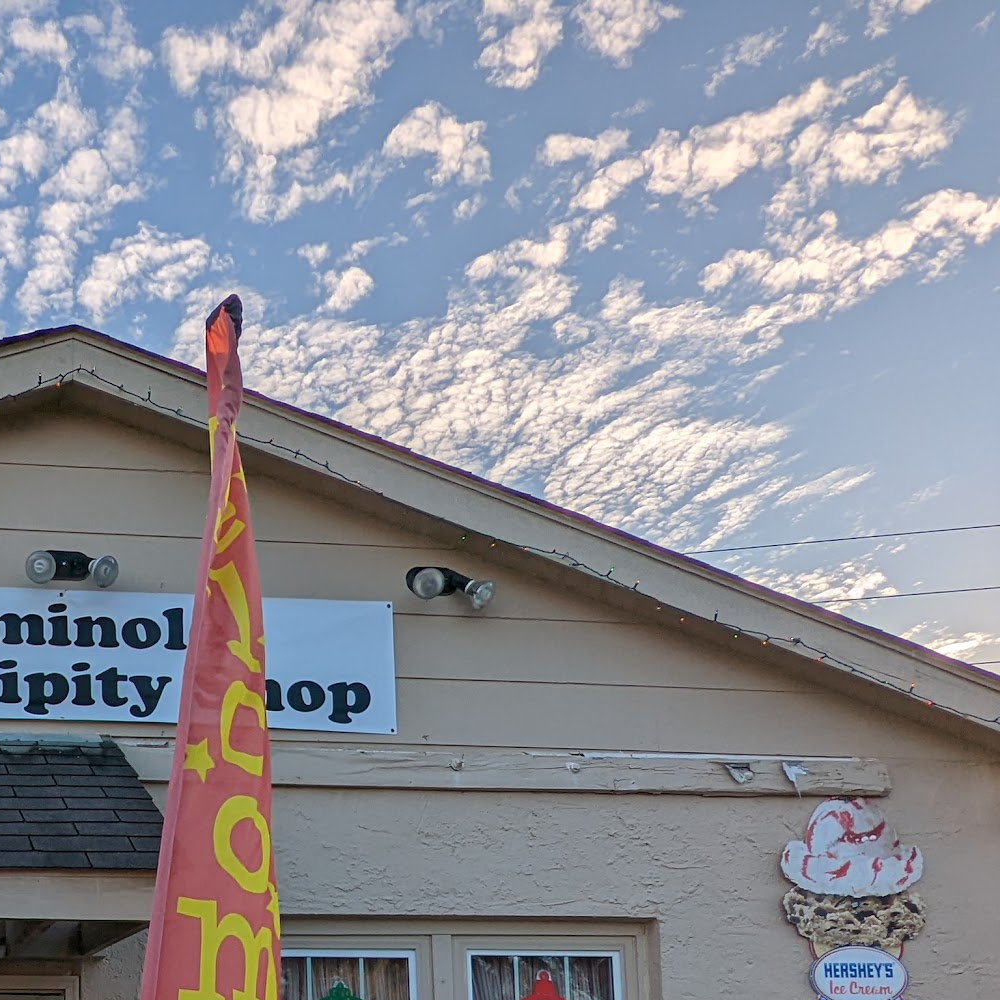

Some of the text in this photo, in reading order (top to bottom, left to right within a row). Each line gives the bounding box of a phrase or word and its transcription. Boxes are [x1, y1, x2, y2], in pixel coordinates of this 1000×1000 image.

[265, 679, 371, 724] op
[823, 962, 895, 979] HERSHEY'S
[829, 980, 893, 995] Ice Cream
